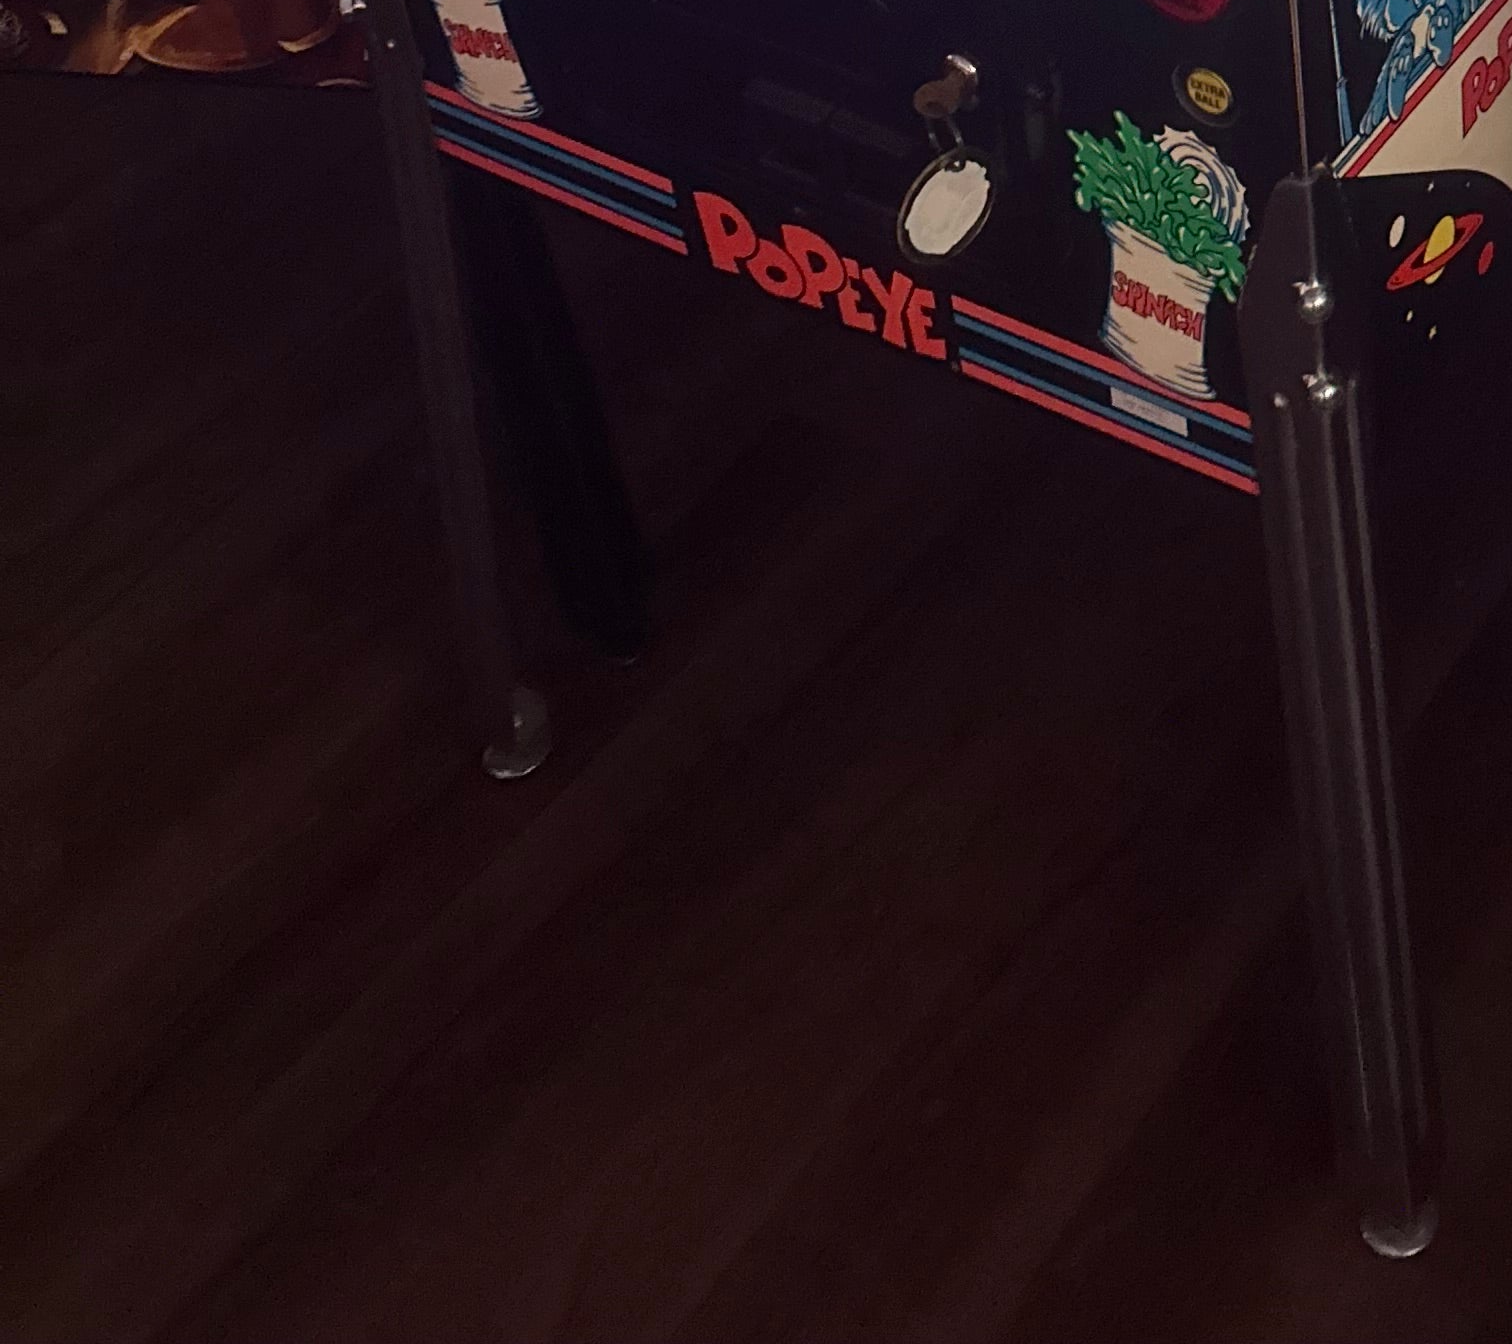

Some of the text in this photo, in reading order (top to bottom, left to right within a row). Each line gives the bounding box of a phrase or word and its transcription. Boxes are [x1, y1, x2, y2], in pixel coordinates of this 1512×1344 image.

[1190, 78, 1226, 99] EXTRA
[1194, 90, 1221, 109] BALL
[693, 191, 947, 361] POPEYE
[1111, 270, 1206, 343] SPINACH
